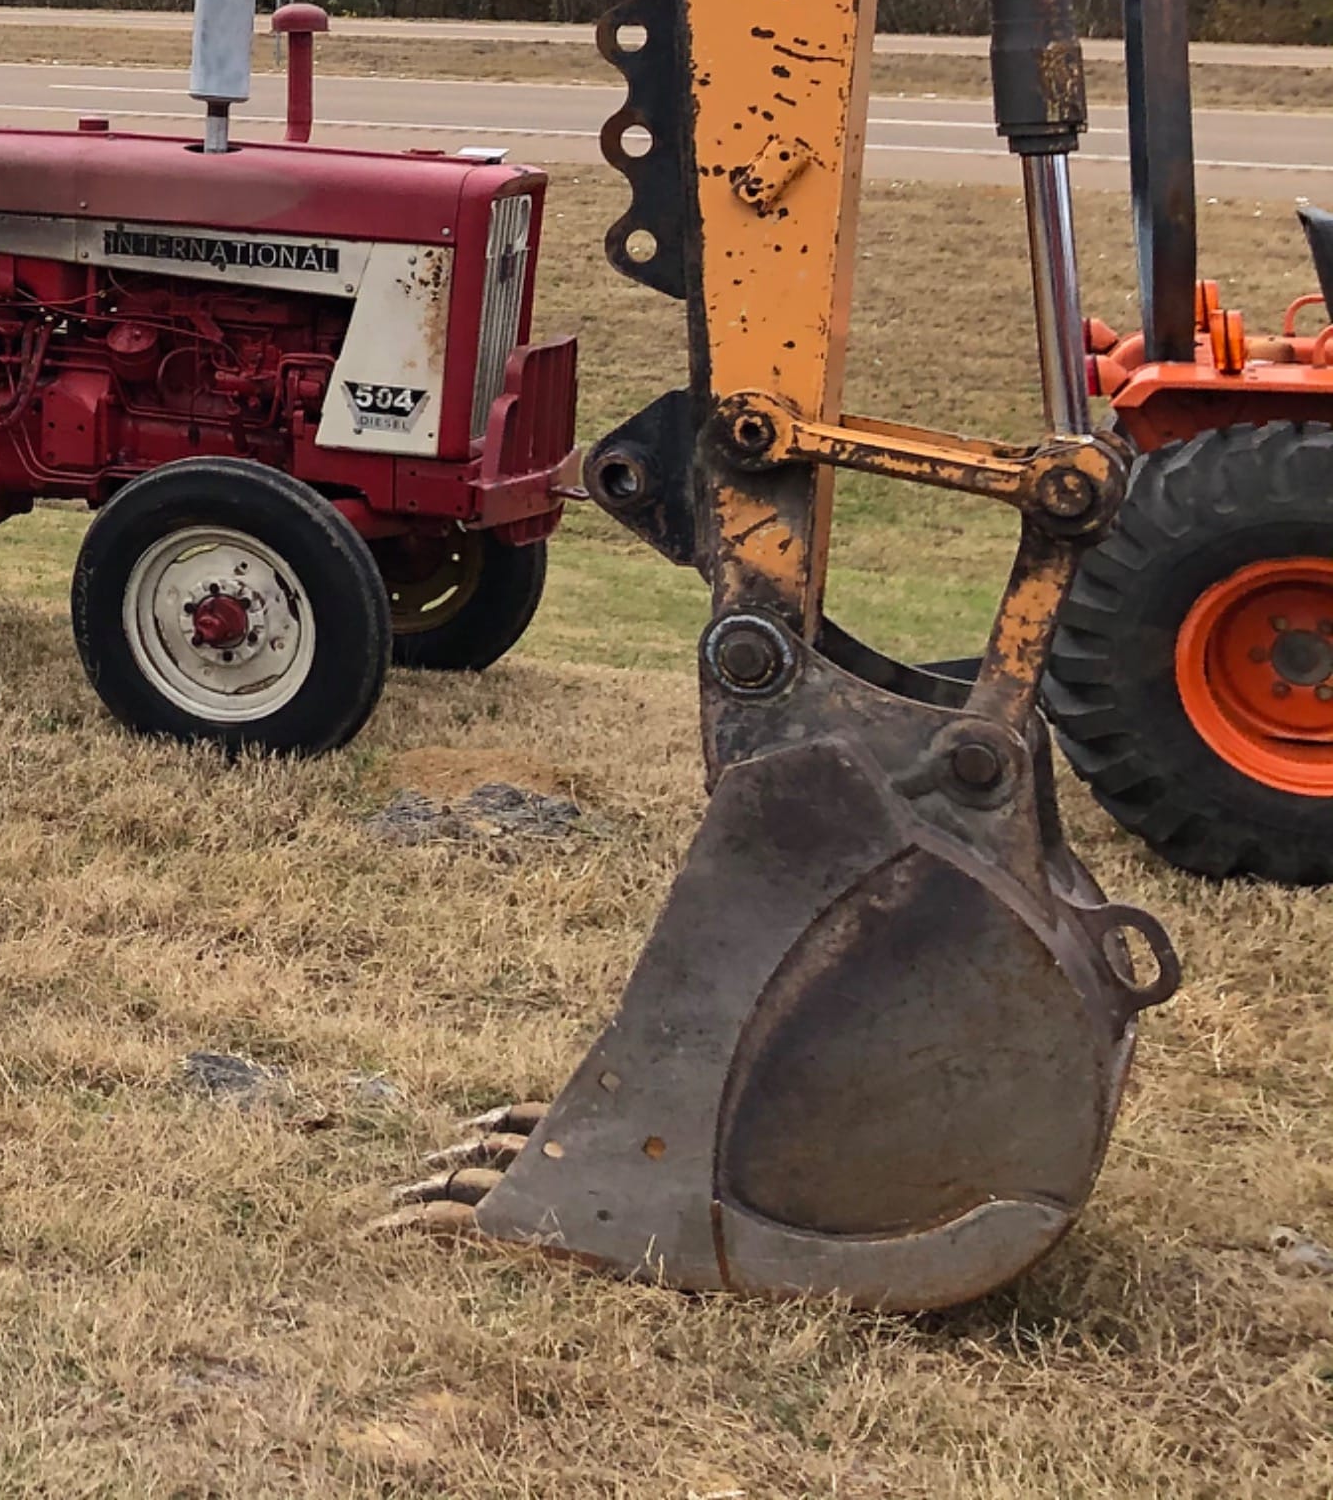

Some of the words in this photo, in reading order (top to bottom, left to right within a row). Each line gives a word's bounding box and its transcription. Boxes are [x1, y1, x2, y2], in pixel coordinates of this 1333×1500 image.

[107, 232, 336, 273] INTERNATIONAL
[355, 384, 414, 412] 504
[359, 415, 408, 432] DIESEL
